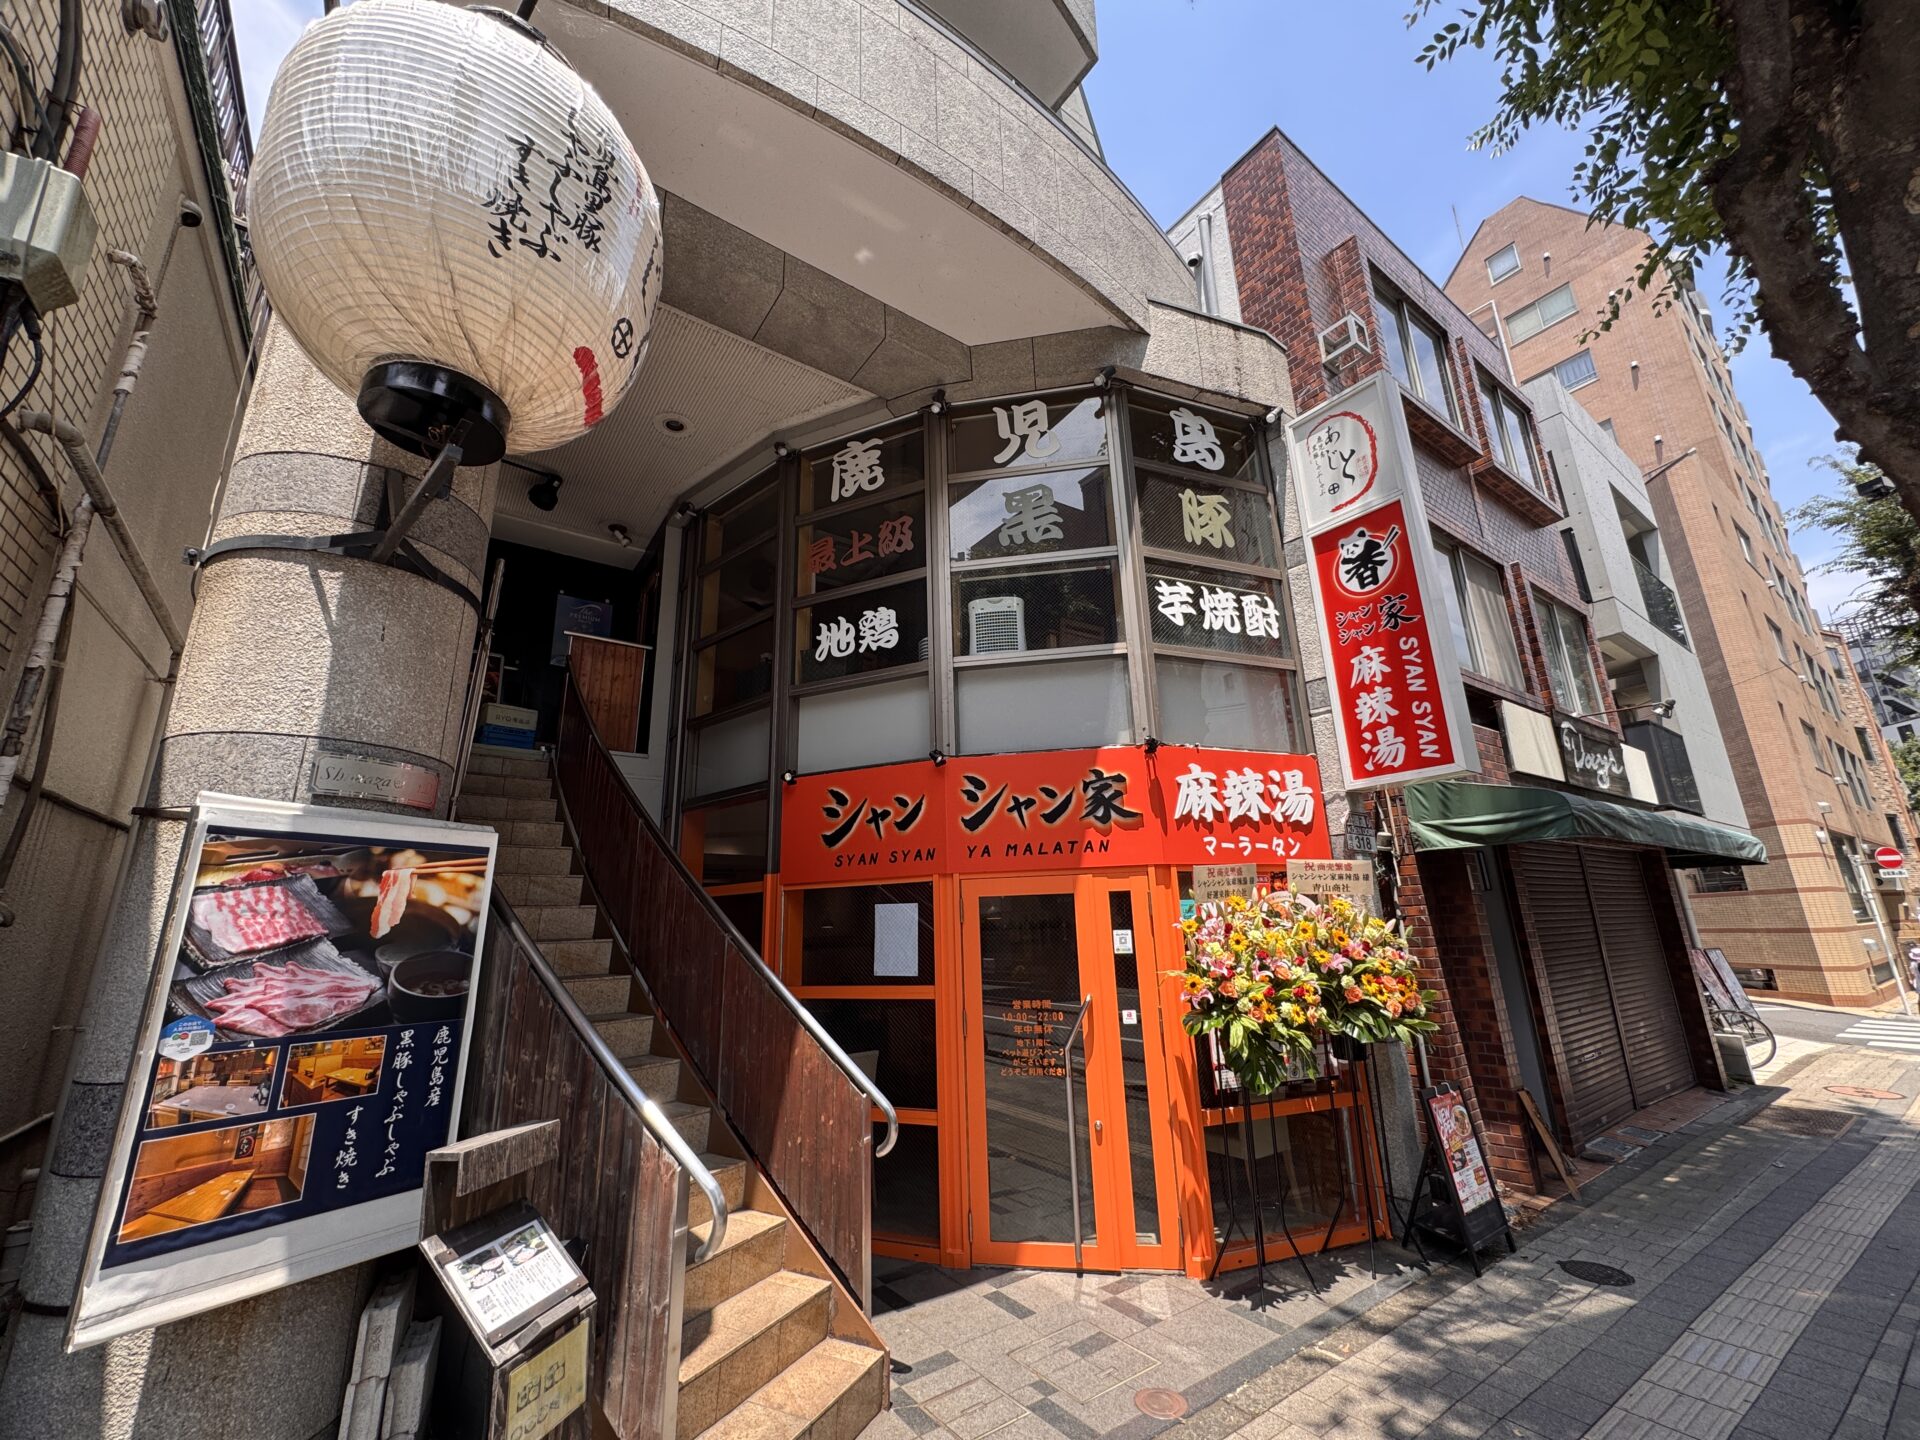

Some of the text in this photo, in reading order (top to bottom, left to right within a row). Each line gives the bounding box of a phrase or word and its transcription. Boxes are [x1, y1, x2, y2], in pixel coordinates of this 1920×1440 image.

[808, 514, 915, 574] 最上級
[814, 579, 1280, 662] 地鶏 芋焼酎
[1350, 644, 1408, 771] 麻辣湯
[1399, 635, 1442, 759] SYAN SYAN
[1173, 762, 1315, 824] 麻辣湯
[834, 839, 1111, 868] SYAN SYAN YA MALATAN
[1202, 835, 1301, 857] マーラータン
[1355, 835, 1372, 850] 318
[1011, 999, 1052, 1010] 営業時間
[423, 1025, 452, 1108] 鹿児島産
[374, 1028, 416, 1179] 黒豚しゃぶしゃぶ
[333, 1104, 365, 1190] すき焼き
